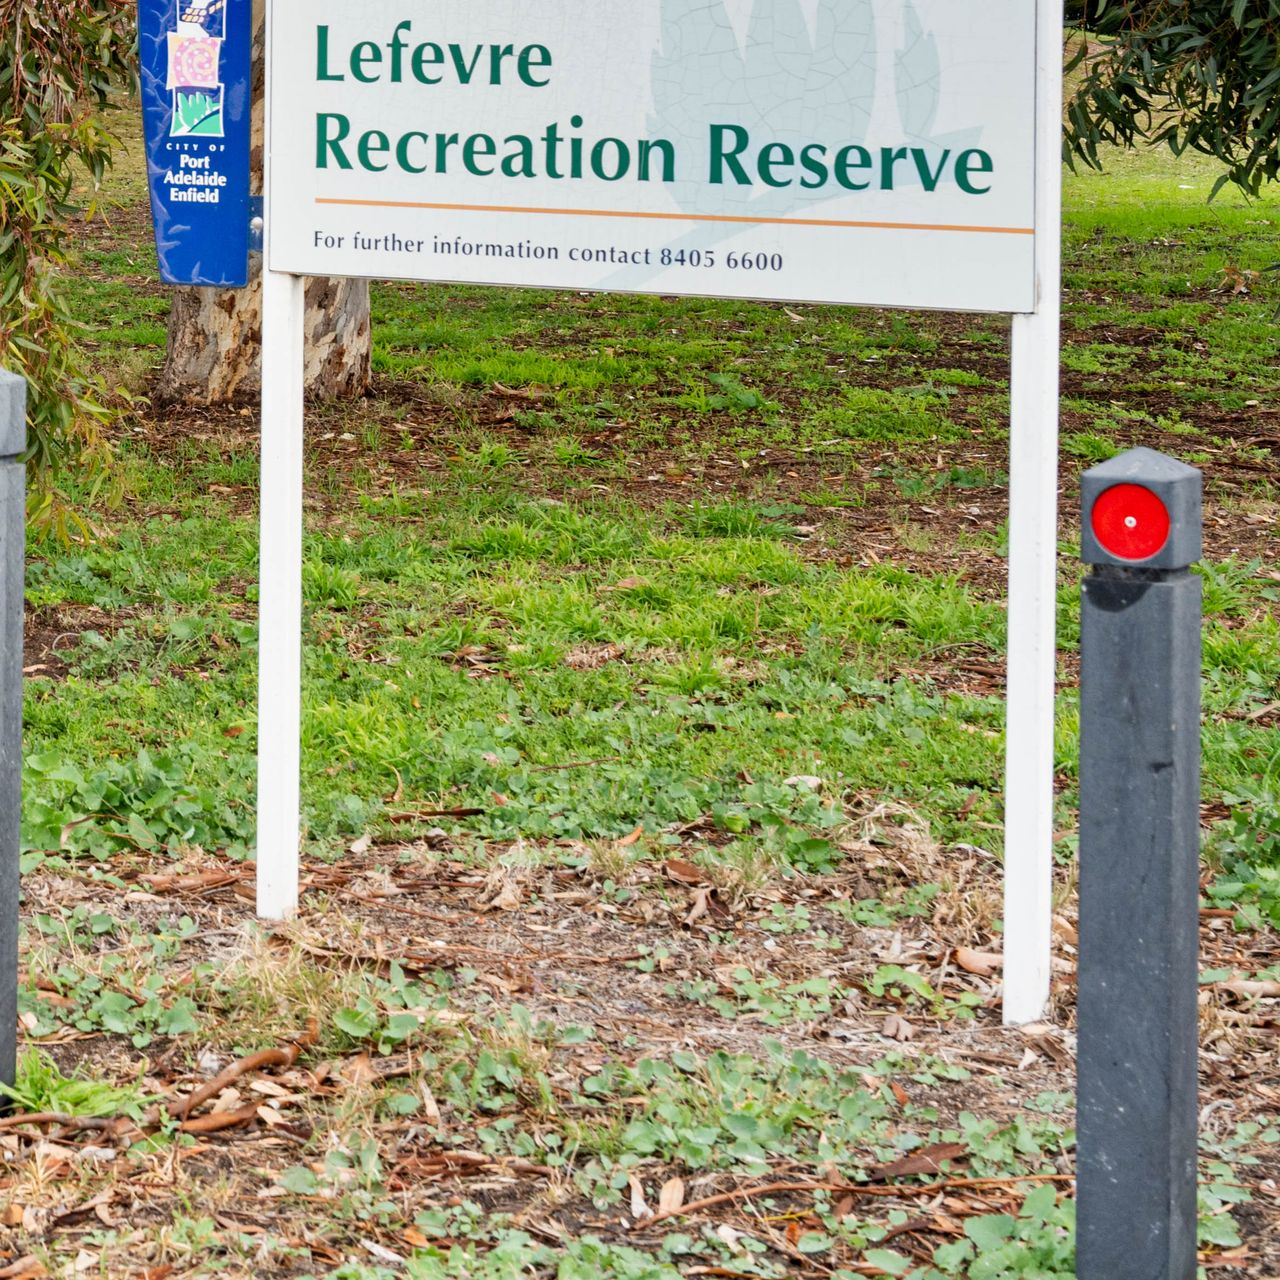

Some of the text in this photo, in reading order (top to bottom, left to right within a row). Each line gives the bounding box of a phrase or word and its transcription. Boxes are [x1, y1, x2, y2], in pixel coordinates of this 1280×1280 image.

[316, 20, 552, 87] Lefevre
[166, 143, 225, 152] CITY OF
[316, 113, 993, 195] Recreation Reserve
[179, 153, 211, 169] Port
[163, 170, 227, 187] Adelaide
[170, 187, 219, 204] Enfield
[313, 231, 783, 271] For further information contact 8405 6600
